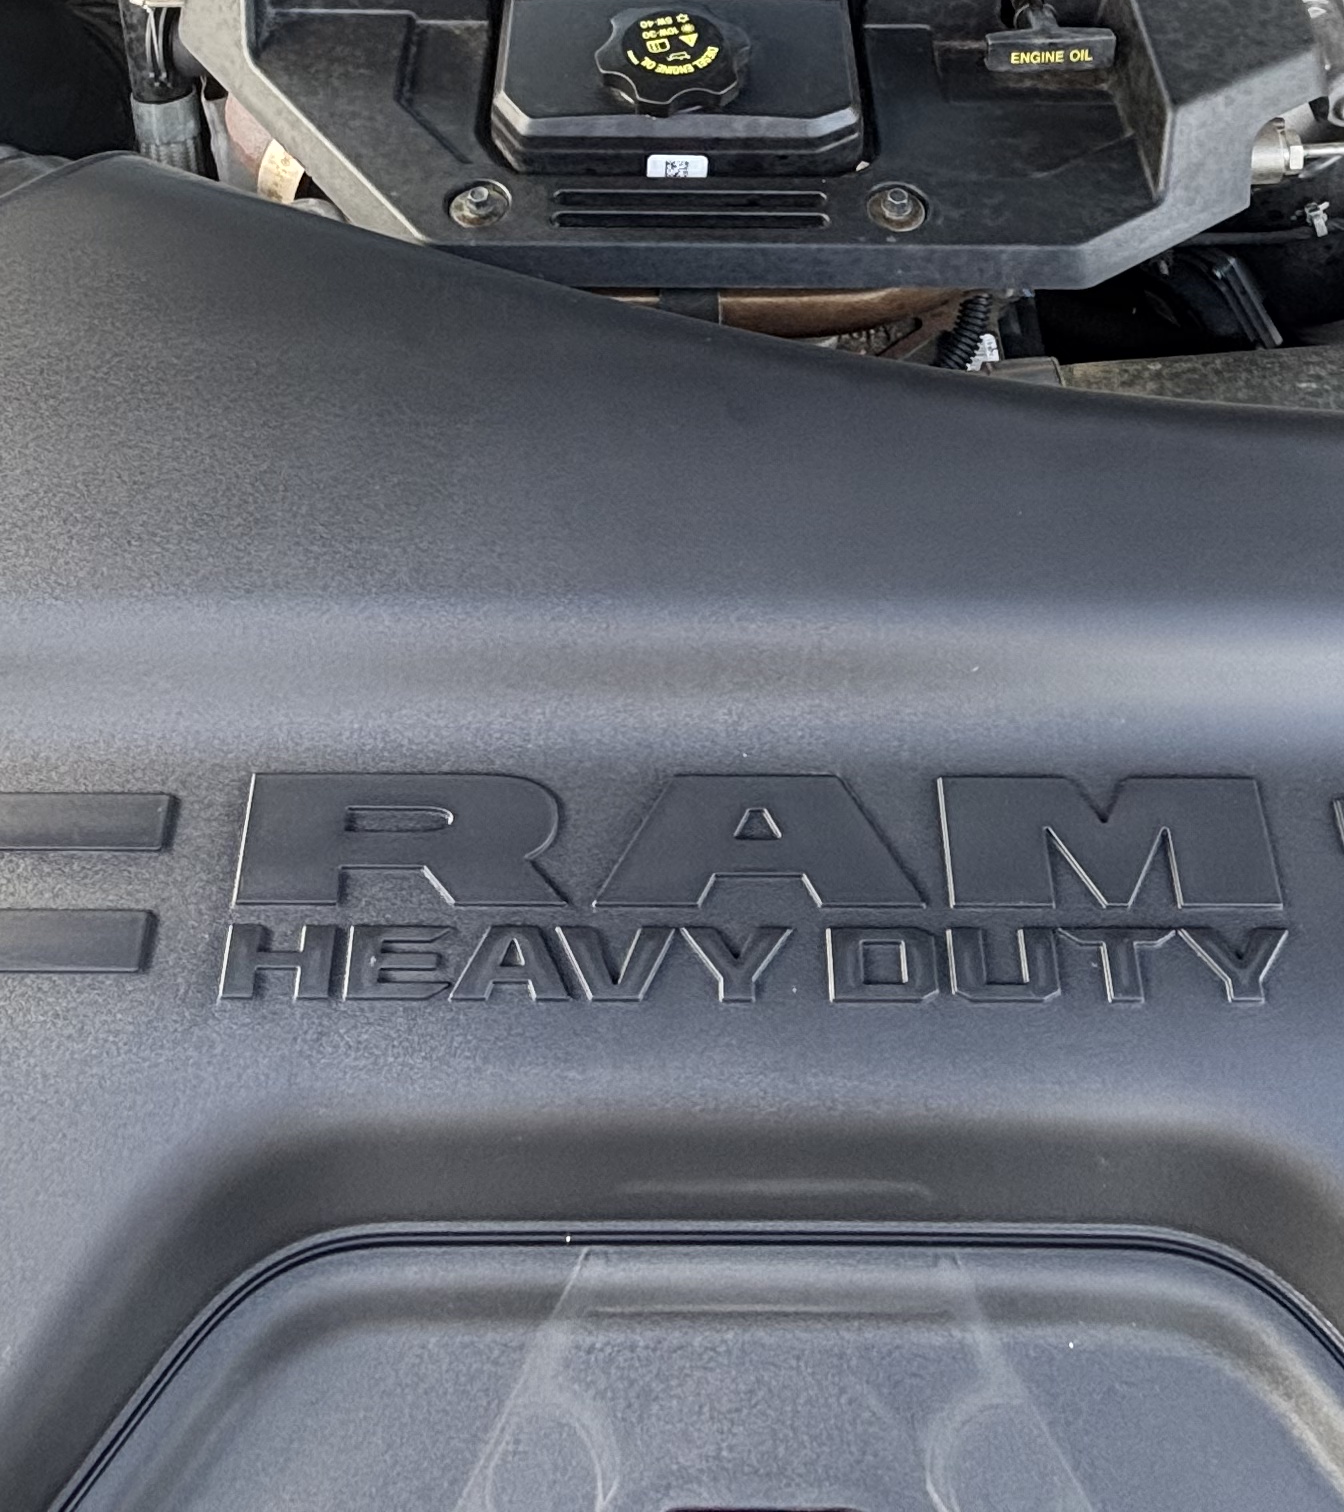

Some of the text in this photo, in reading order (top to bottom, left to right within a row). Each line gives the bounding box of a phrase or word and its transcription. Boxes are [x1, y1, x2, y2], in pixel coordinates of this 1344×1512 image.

[639, 16, 673, 29] 5W-40
[641, 26, 679, 40] 10W-30
[1010, 48, 1094, 65] ENGINE OIL
[231, 772, 1283, 910] RAM
[218, 924, 1289, 1004] HEAVY DUTY
